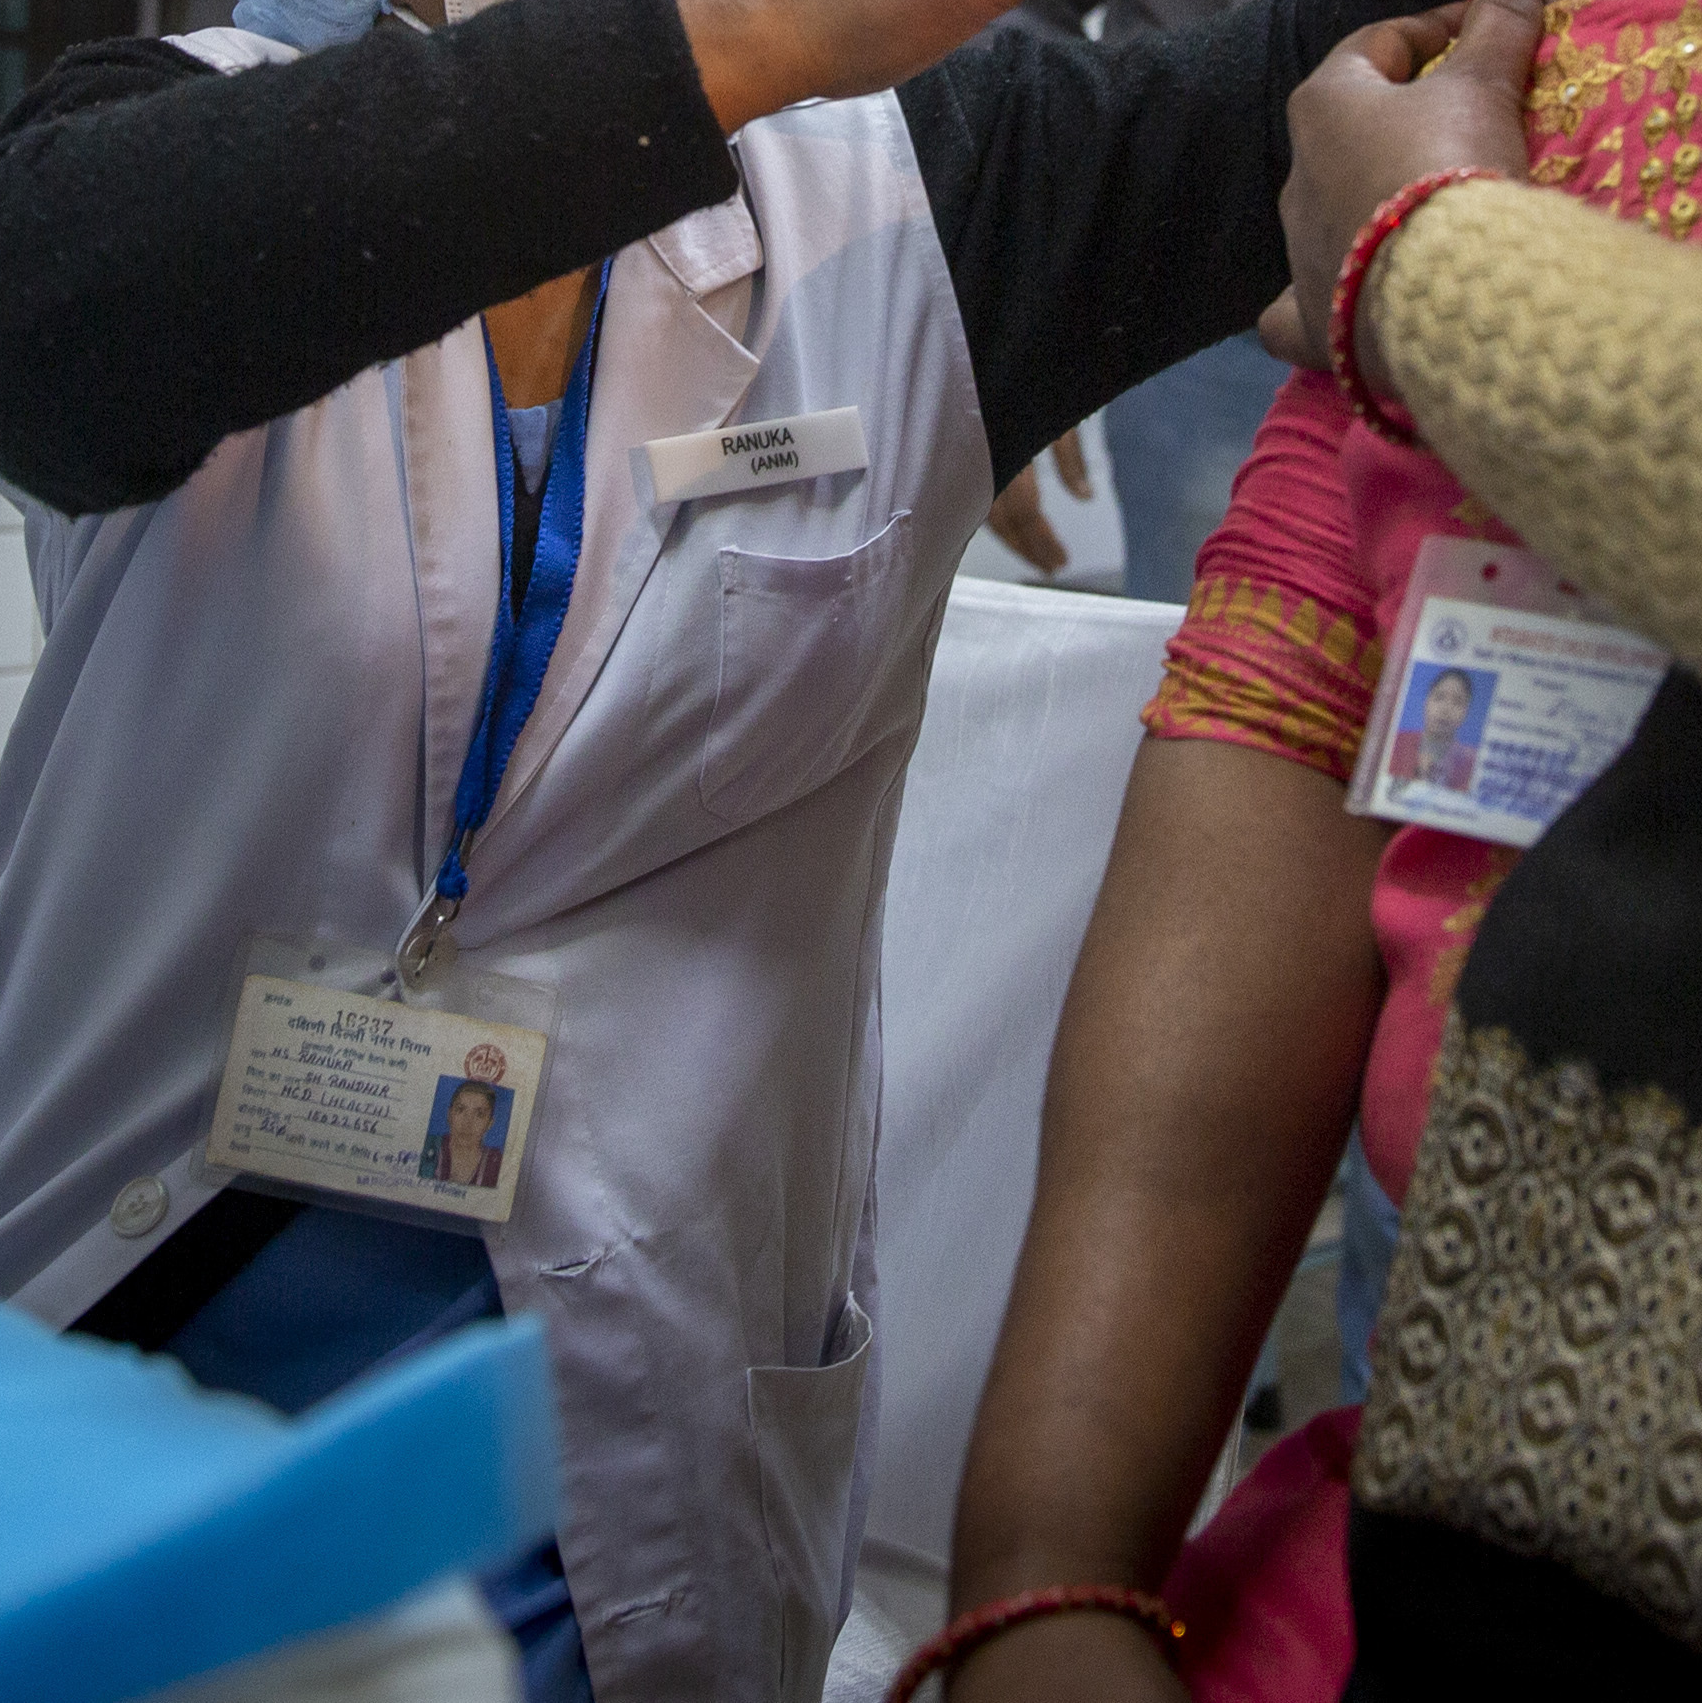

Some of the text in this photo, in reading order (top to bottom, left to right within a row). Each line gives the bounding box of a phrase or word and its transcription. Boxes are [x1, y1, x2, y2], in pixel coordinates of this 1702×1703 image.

[721, 427, 794, 456] RANUKA
[750, 450, 799, 475] (ANM)
[330, 1021, 365, 1043] दिल्ली
[370, 1034, 395, 1049] नगर
[400, 1037, 432, 1056] निगम
